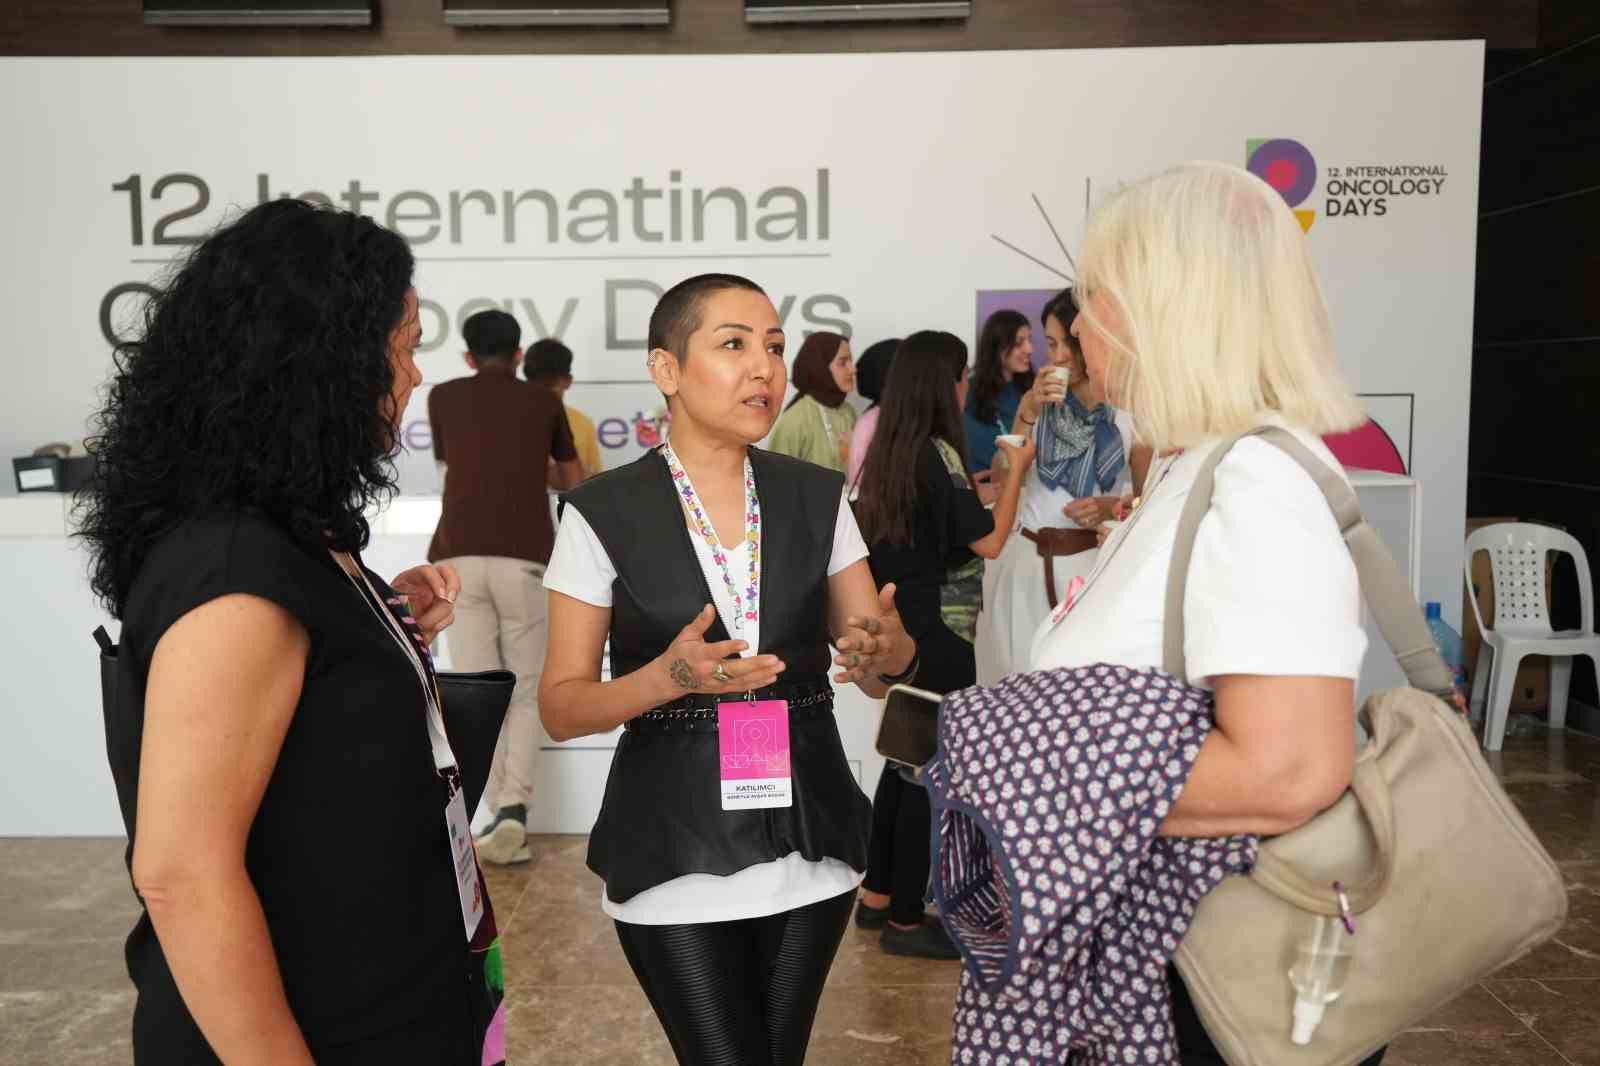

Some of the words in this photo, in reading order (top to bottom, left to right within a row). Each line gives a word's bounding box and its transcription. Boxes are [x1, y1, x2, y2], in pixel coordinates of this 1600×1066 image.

[1345, 165, 1448, 176] INTERNATIONAL
[1327, 178, 1445, 195] ONCOLOGY
[112, 172, 211, 247] 12
[257, 168, 830, 246] ternatinal
[1326, 198, 1387, 216] DAYS
